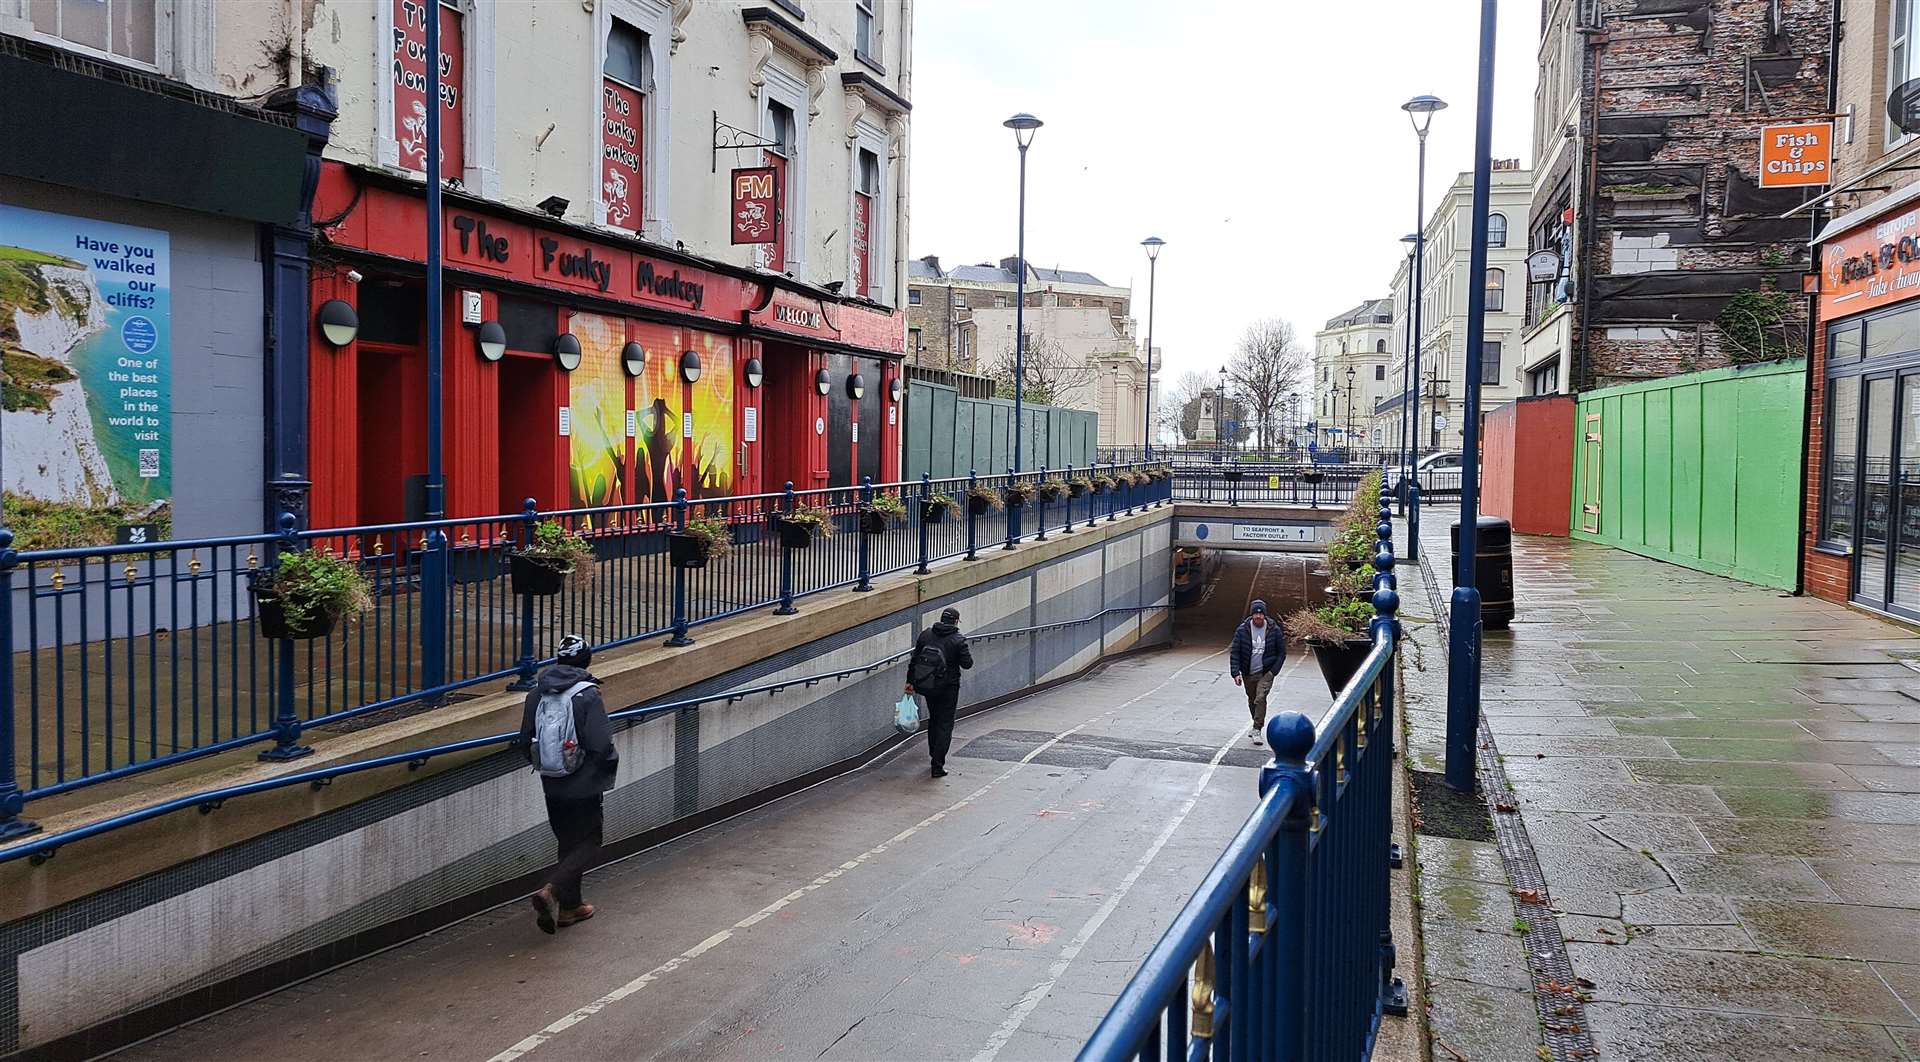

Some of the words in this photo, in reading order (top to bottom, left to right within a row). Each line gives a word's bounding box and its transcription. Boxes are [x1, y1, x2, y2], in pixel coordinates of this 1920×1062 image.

[604, 86, 630, 115] The
[602, 112, 636, 147] unky
[1775, 132, 1818, 148] Fish
[602, 143, 640, 173] onkey
[1790, 147, 1804, 159] &
[1767, 160, 1825, 175] Chips
[736, 174, 773, 200] FM
[76, 235, 119, 253] Have
[124, 245, 153, 258] you
[94, 258, 155, 275] walked
[453, 215, 509, 263] The
[540, 238, 611, 292] Funky
[637, 261, 704, 310] Monkey
[128, 280, 156, 292] our
[1866, 276, 1888, 298] Take
[107, 292, 155, 309] cliffs?
[776, 304, 820, 328] WELCOME
[117, 357, 142, 368] One
[145, 359, 158, 369] of
[108, 371, 129, 382] the
[132, 372, 158, 383] best
[120, 387, 158, 398] places
[124, 401, 135, 411] in
[138, 402, 158, 412] the
[108, 416, 144, 426] world
[147, 417, 159, 426] to
[134, 431, 159, 440] visit
